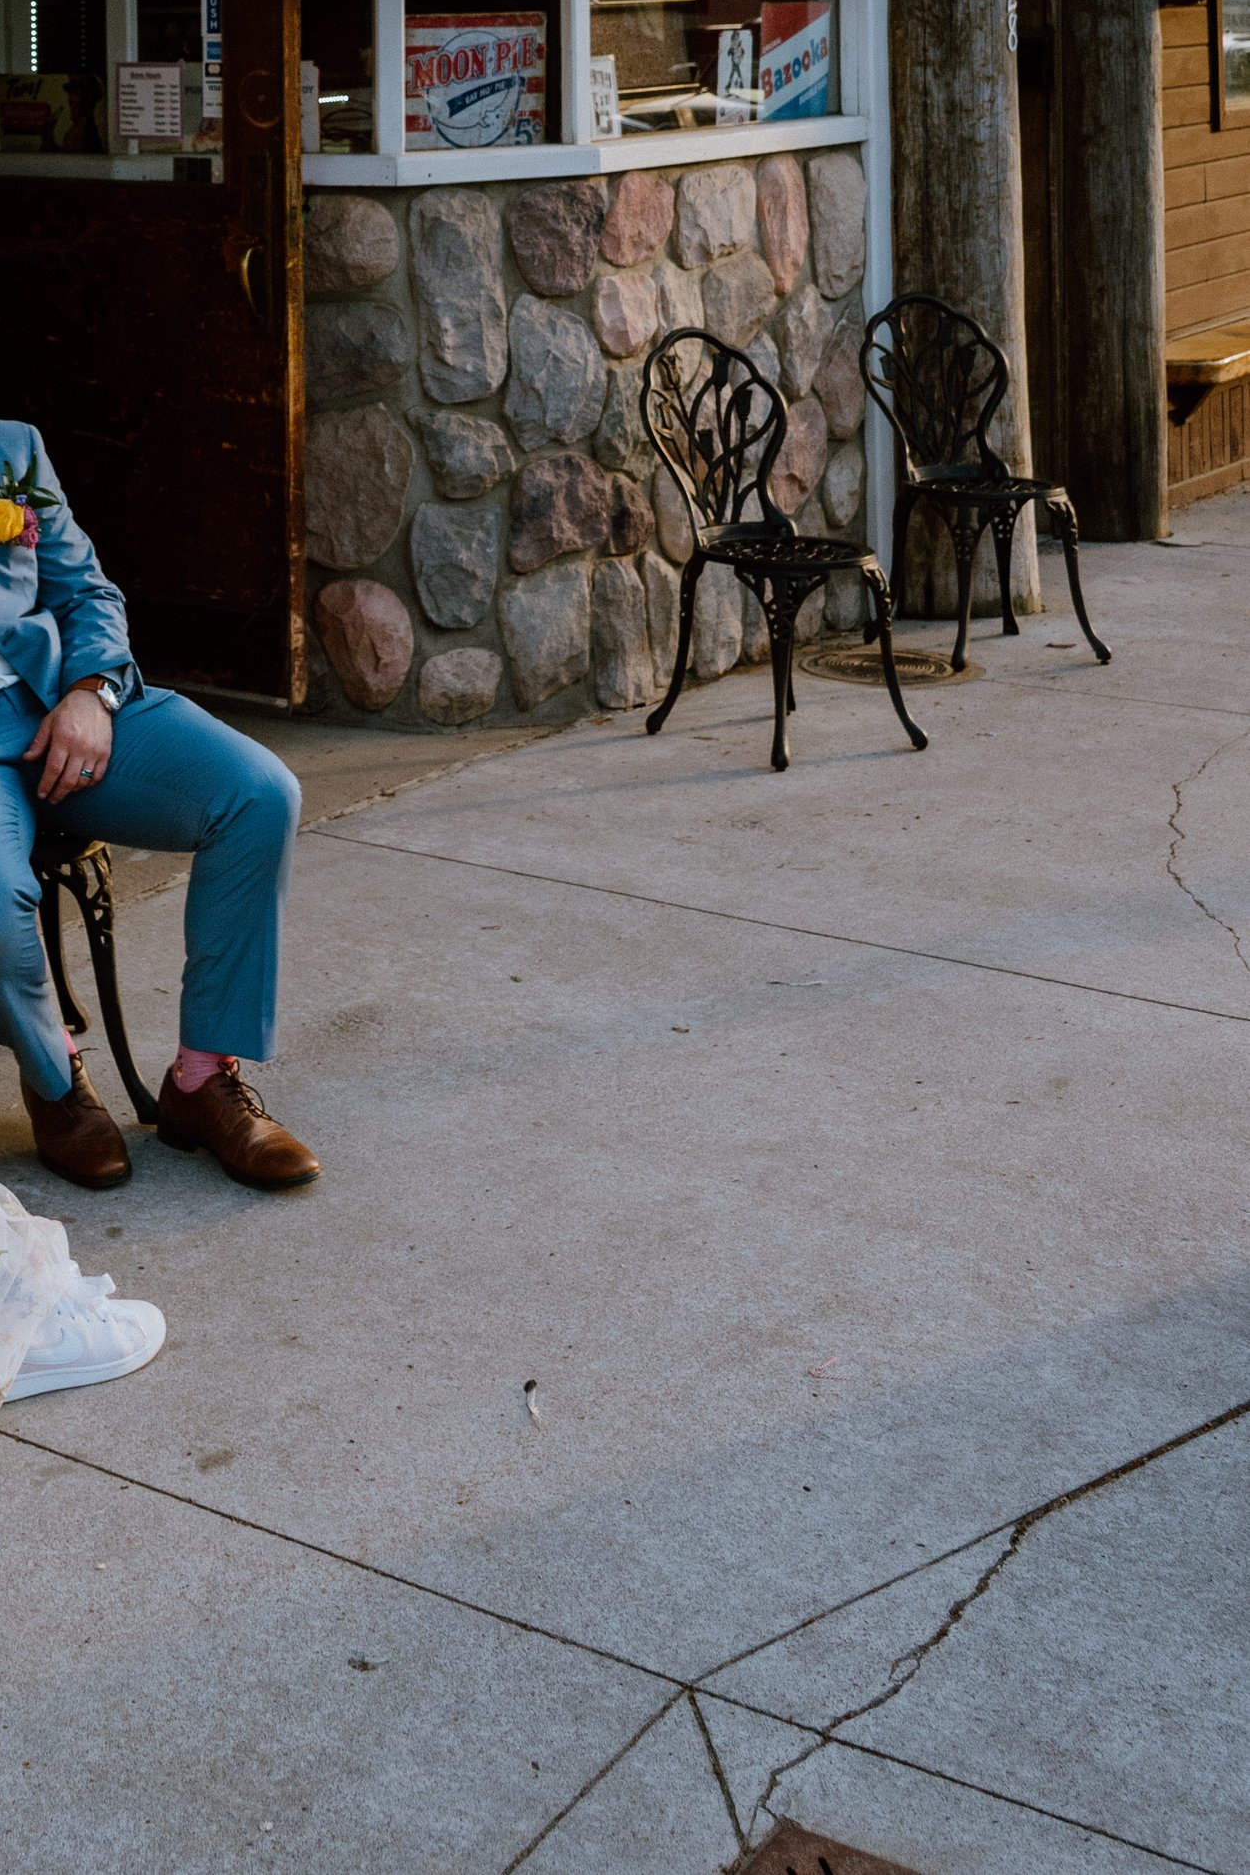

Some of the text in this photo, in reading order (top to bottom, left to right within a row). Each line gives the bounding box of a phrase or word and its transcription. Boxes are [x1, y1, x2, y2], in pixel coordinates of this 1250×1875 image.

[412, 34, 536, 90] MOON PIE
[760, 36, 828, 100] Bazooka
